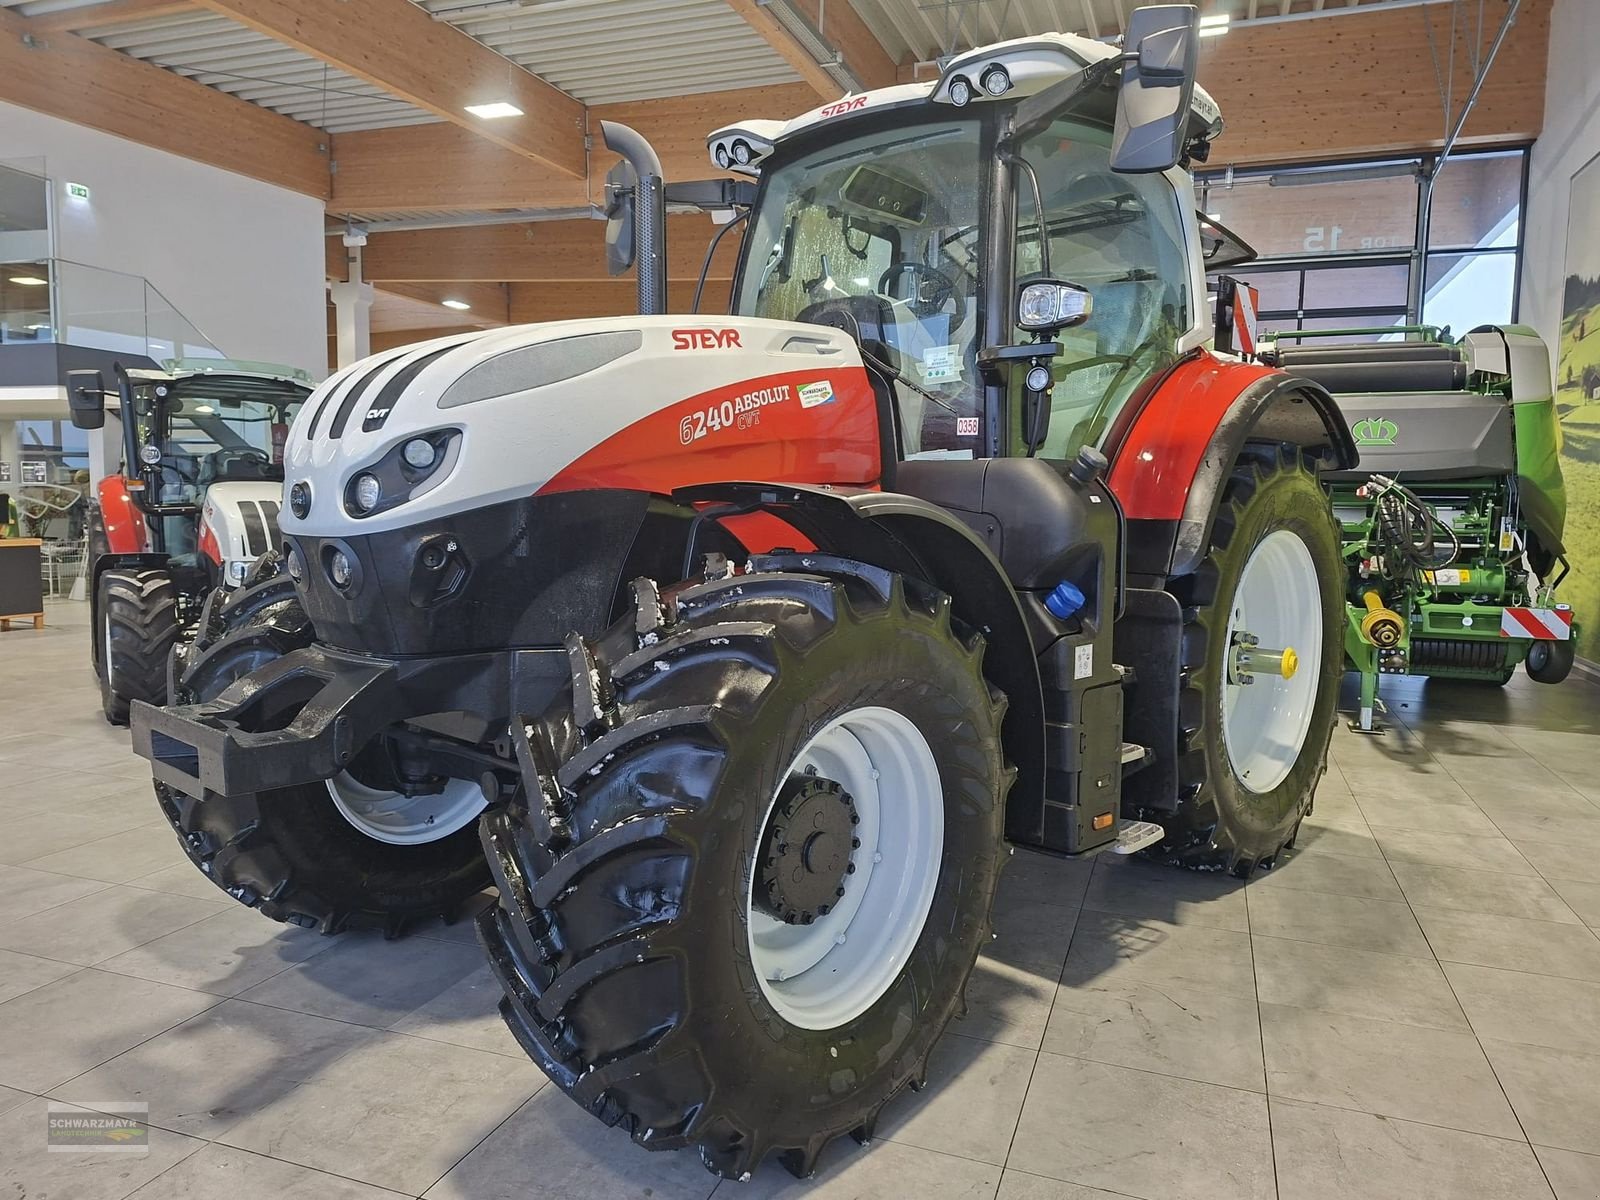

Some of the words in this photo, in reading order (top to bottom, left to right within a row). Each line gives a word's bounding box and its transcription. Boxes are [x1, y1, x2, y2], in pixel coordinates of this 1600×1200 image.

[821, 96, 868, 117] STEYR
[671, 328, 743, 350] STEYR
[366, 408, 390, 419] CVT
[679, 400, 734, 445] 6240
[735, 385, 791, 414] ABSOLUT
[737, 410, 760, 430] CVT
[958, 419, 978, 433] 0358
